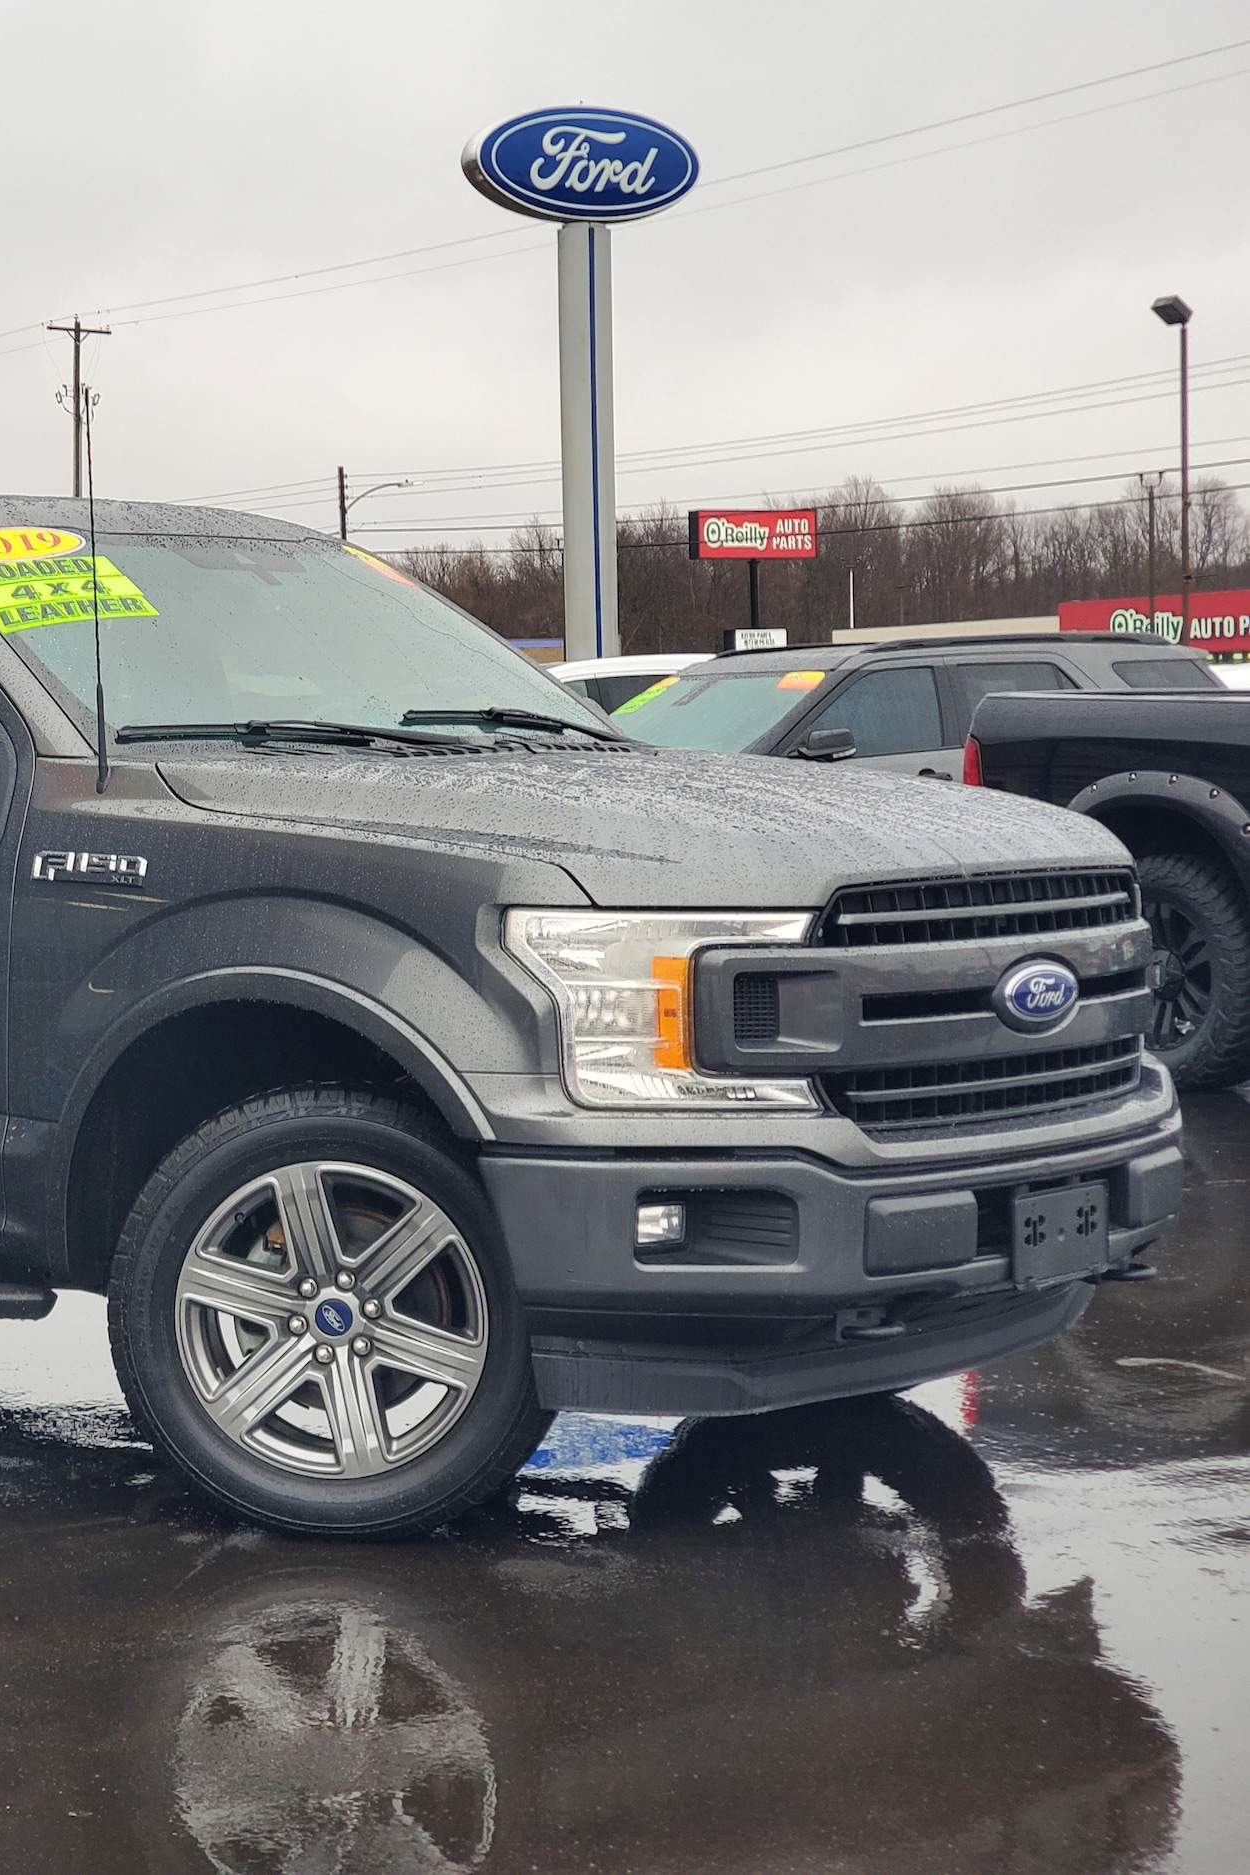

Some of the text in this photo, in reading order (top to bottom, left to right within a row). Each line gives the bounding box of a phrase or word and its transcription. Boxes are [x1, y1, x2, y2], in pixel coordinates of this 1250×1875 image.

[530, 125, 659, 195] Ford
[704, 517, 809, 550] O'Reilly AUTO
[772, 534, 813, 550] PARTS
[1110, 608, 1184, 644] O'Rilly
[1190, 616, 1235, 639] AUTO
[1027, 977, 1065, 1009] Ford
